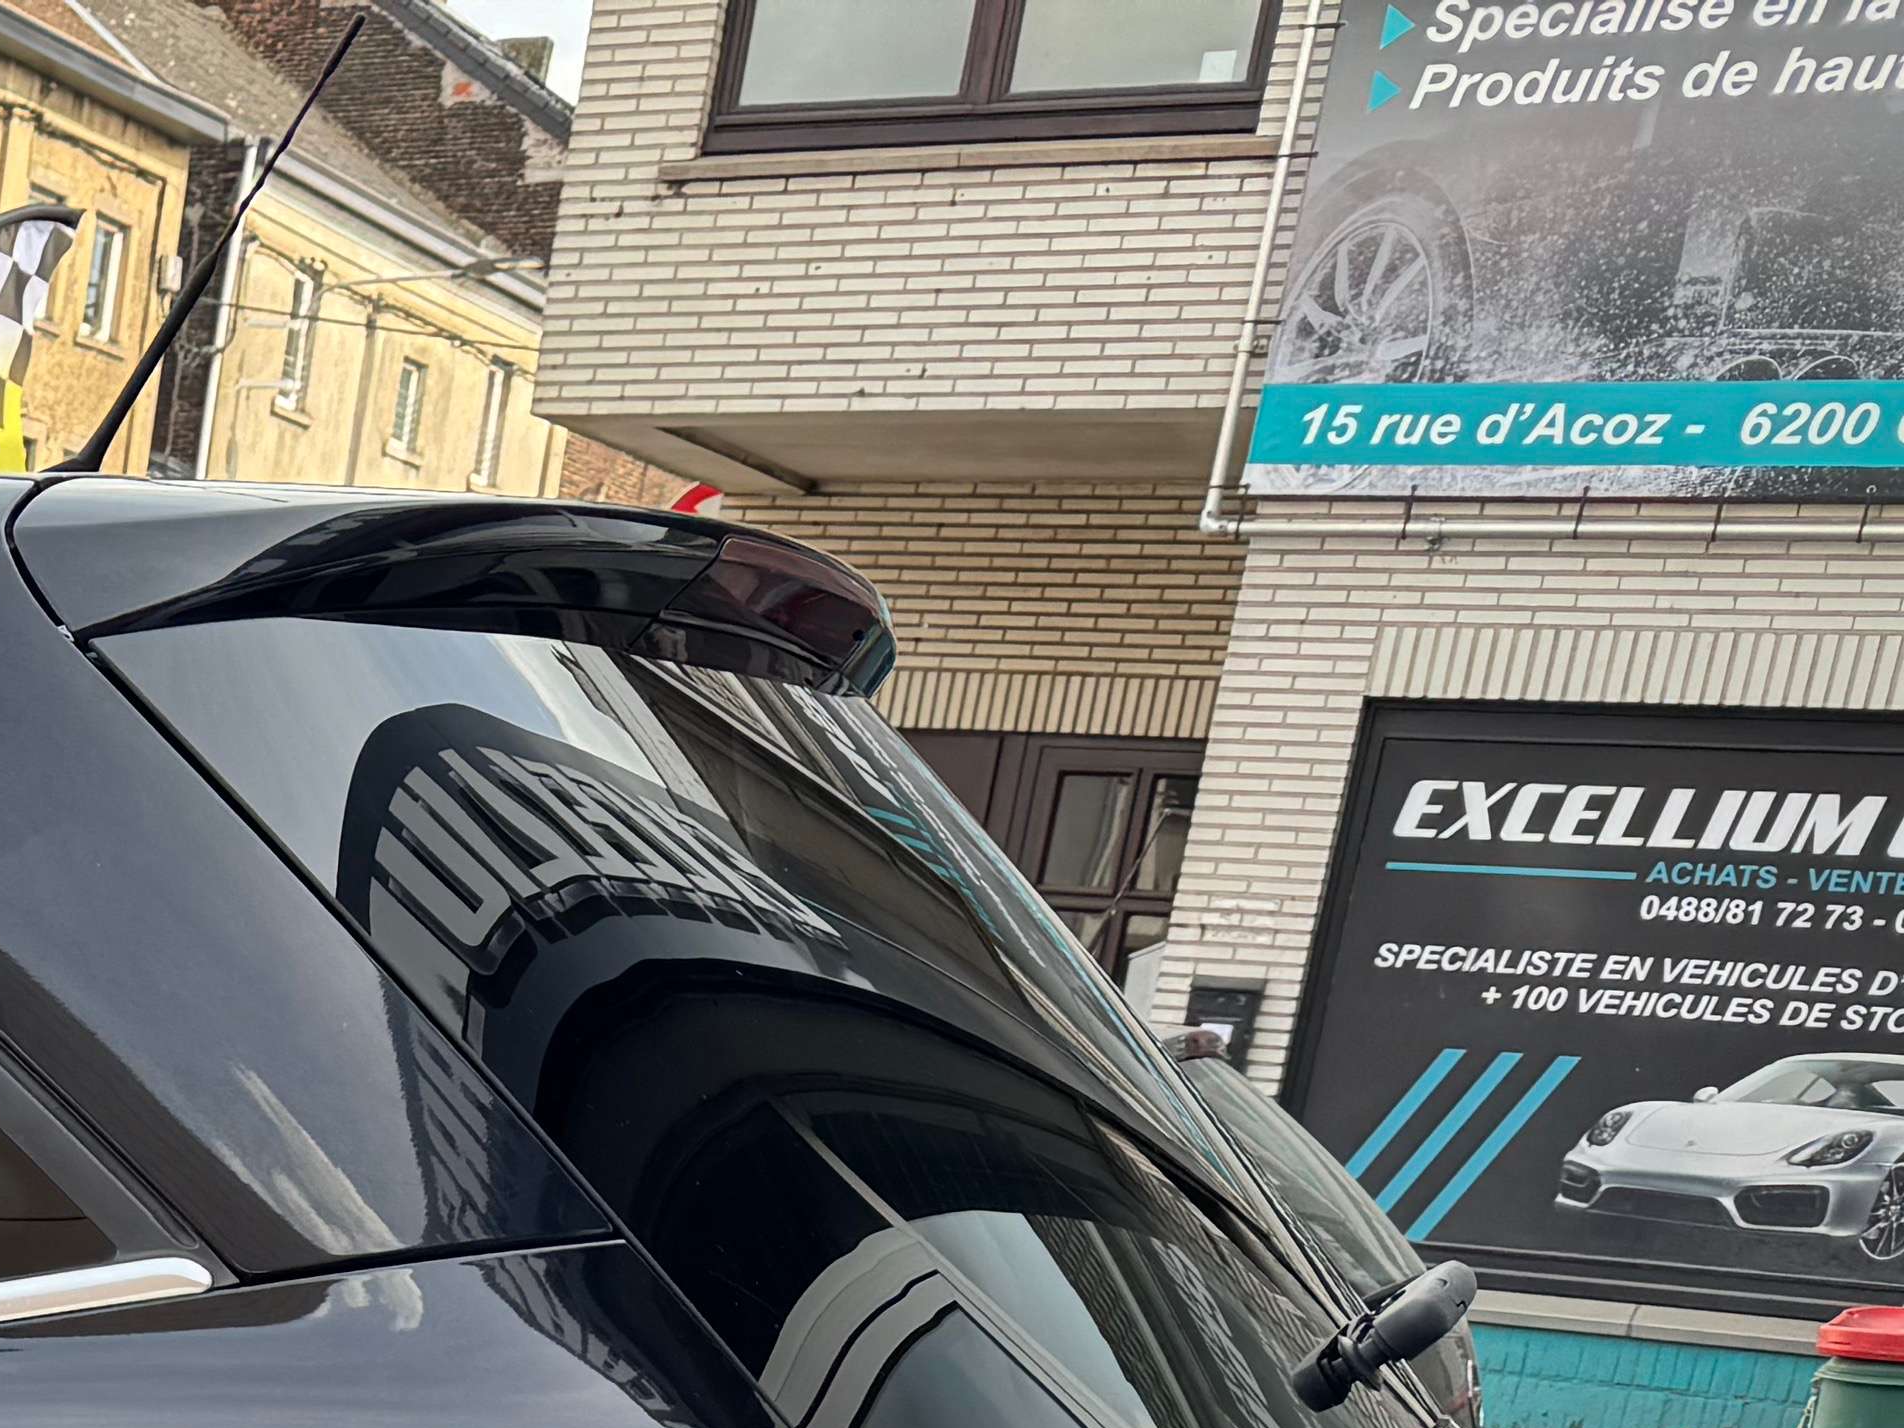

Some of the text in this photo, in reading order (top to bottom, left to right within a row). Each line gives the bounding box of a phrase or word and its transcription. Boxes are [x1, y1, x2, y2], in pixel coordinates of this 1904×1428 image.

[1408, 56, 1666, 109] Produits
[1682, 50, 1759, 98] de
[1301, 403, 1363, 445] 15
[1369, 413, 1462, 445] rue
[1476, 402, 1673, 445] d'Acoz
[1740, 402, 1881, 445] 6200
[1392, 779, 1888, 856] EXCELLIUM
[1644, 861, 1778, 889] ACHATS
[1640, 895, 1764, 925] 0488/81
[1775, 902, 1815, 929] 72
[1824, 904, 1864, 930] 73
[1374, 942, 1598, 979] SPECIALISTE
[1599, 955, 1654, 981] EN
[1663, 957, 1863, 994] VEHICULES
[1481, 985, 1502, 1005] +
[1511, 984, 1569, 1012] 100
[1578, 987, 1775, 1024] VEHICULES
[1779, 1001, 1836, 1028] DE
